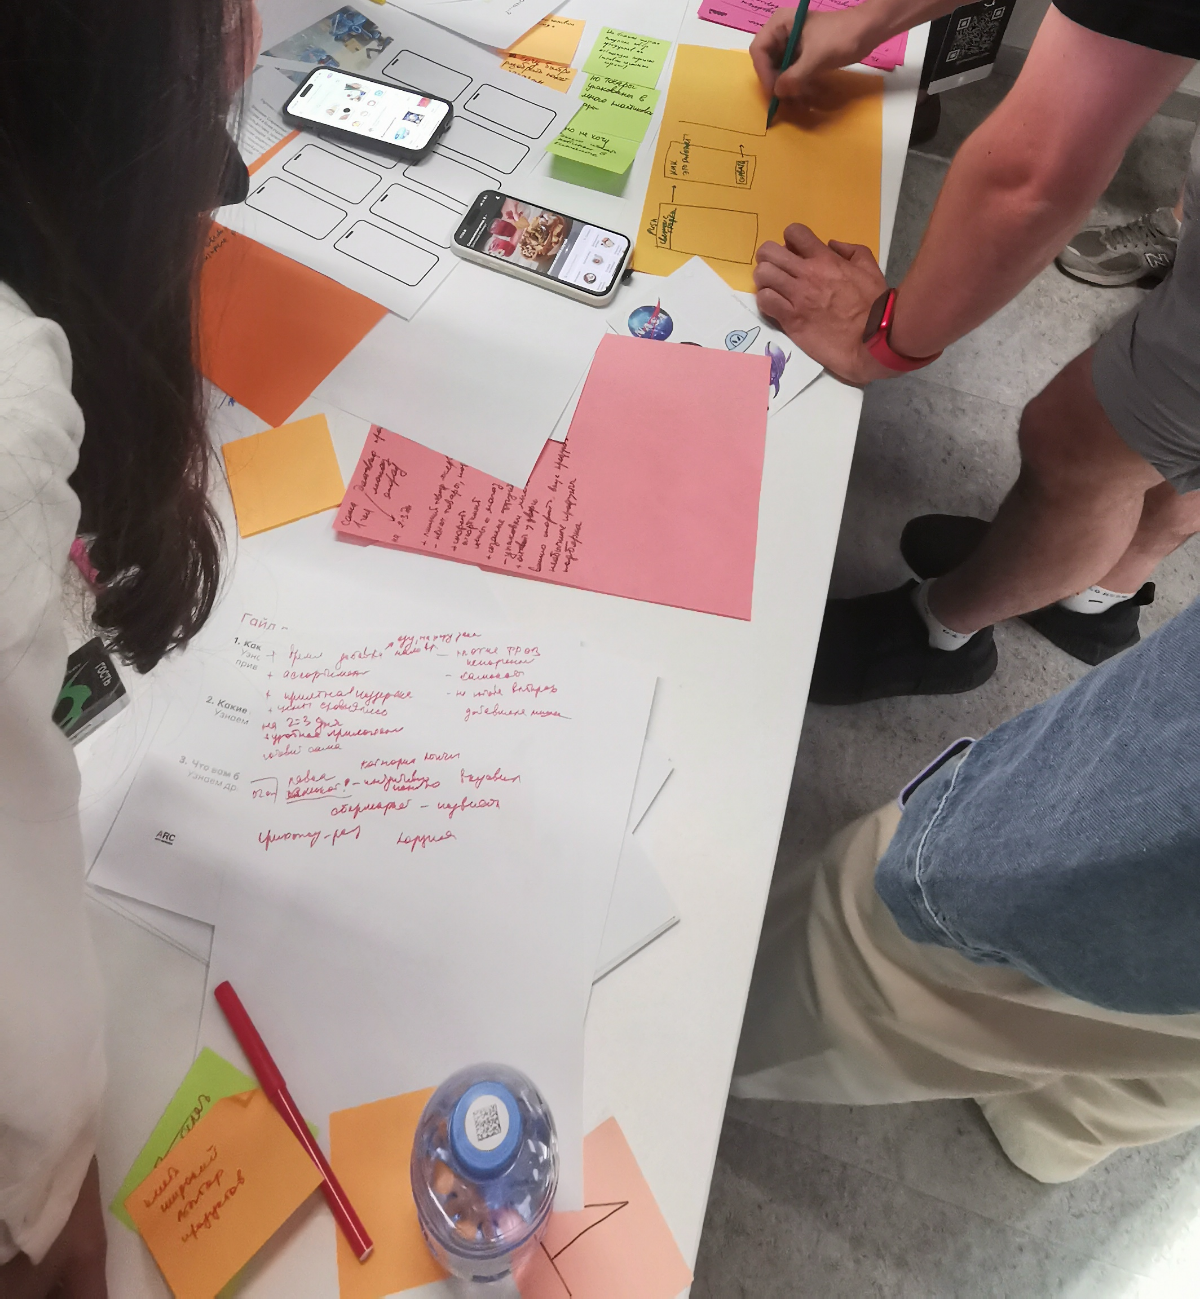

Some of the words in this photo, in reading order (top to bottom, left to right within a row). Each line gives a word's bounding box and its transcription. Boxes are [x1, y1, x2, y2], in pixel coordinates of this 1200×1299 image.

[634, 311, 669, 339] NASA
[243, 640, 263, 652] Как
[216, 699, 249, 715] Какие
[214, 708, 250, 726] Узнаем
[191, 758, 211, 772] Что
[186, 770, 223, 788] Узнаем
[155, 829, 177, 843] ARC
